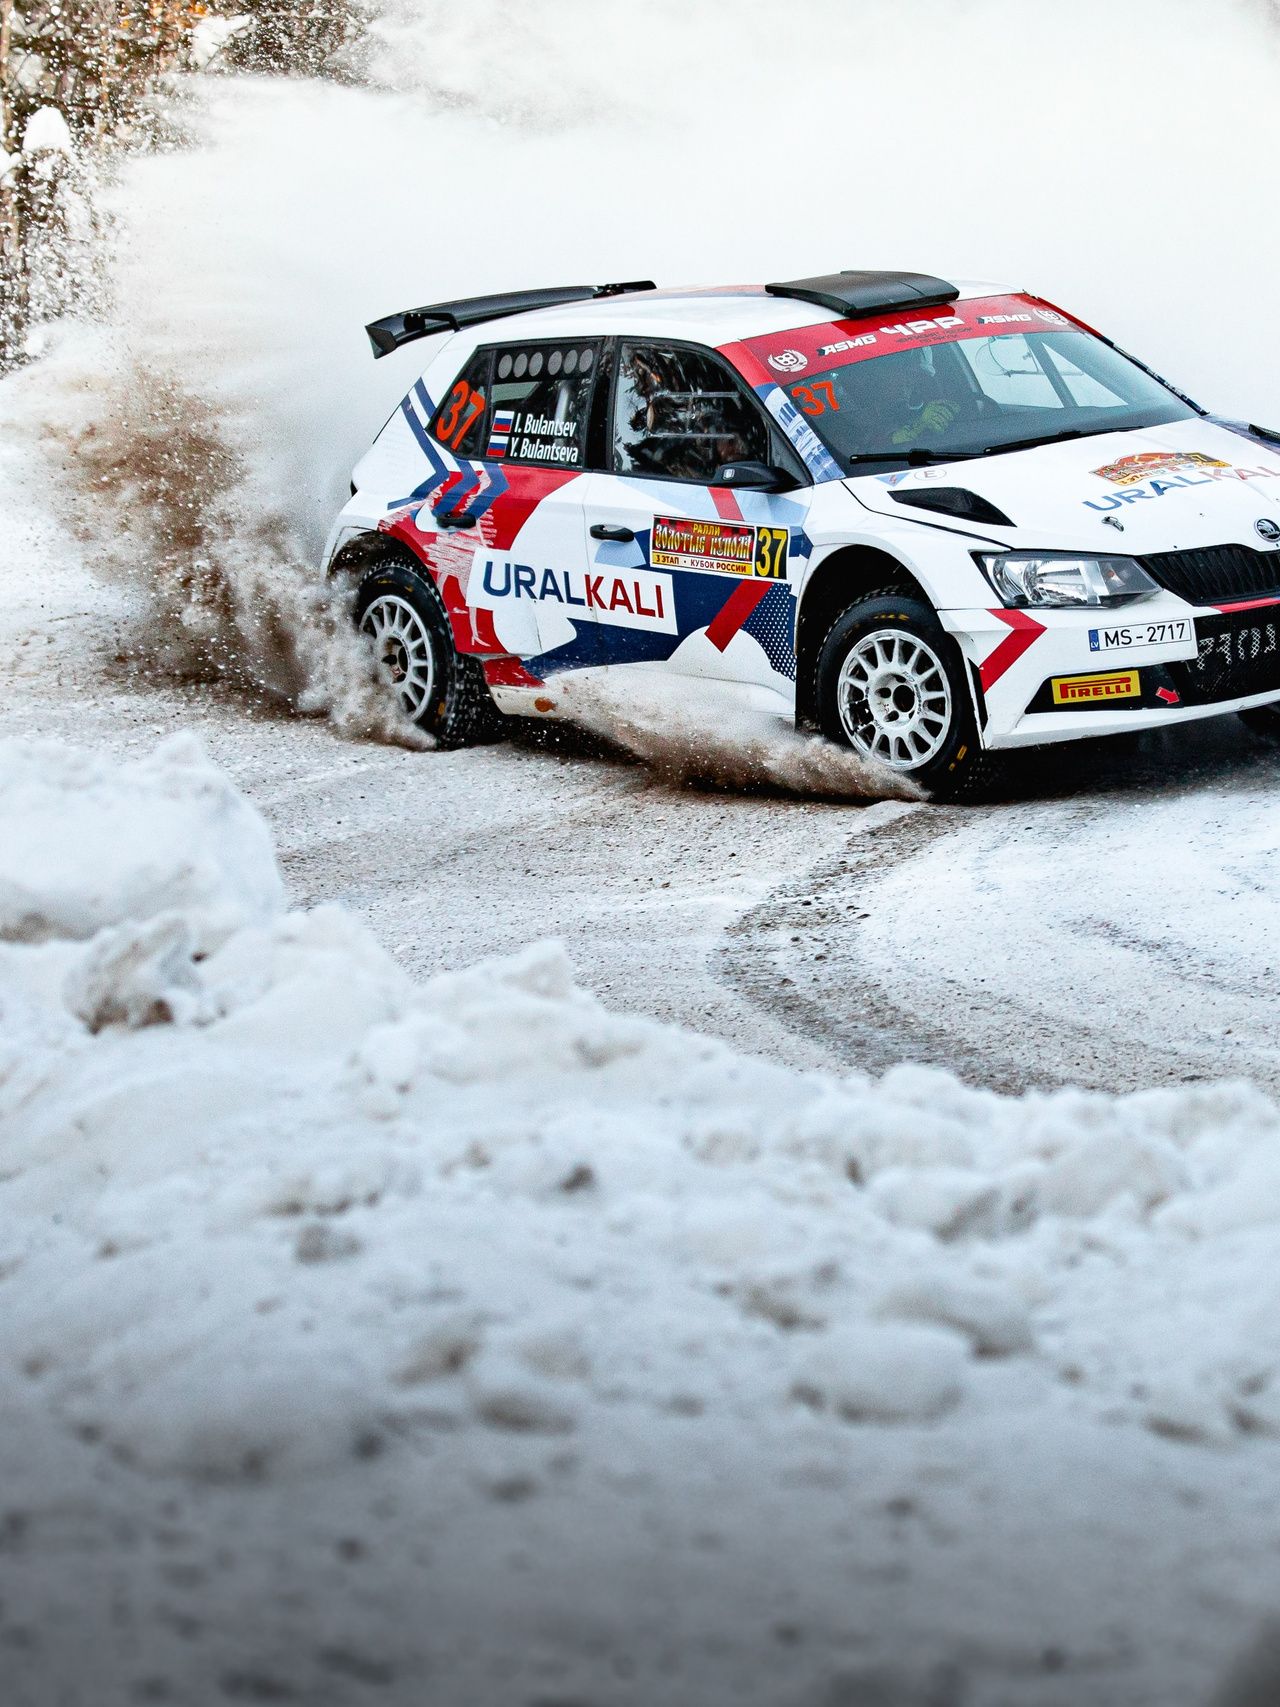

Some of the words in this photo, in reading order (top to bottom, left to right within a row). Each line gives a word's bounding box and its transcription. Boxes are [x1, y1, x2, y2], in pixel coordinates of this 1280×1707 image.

[981, 314, 1032, 324] ASMG
[823, 334, 877, 356] ASMG
[791, 381, 840, 416] 37
[436, 380, 486, 450] 37
[514, 412, 522, 433] I.
[523, 413, 577, 438] Bulantsev
[509, 436, 518, 457] Y.
[519, 438, 579, 463] Bulantseva
[692, 523, 720, 537] РАЛЛИ
[656, 554, 661, 563] 3
[661, 556, 680, 565] ЭТАП
[690, 559, 715, 569] КУБОК
[716, 562, 747, 573] РОССИИ
[755, 527, 787, 578] 37
[482, 561, 664, 619] URALKALI
[1090, 641, 1099, 649] LV
[1059, 676, 1132, 699] PIRELLI
